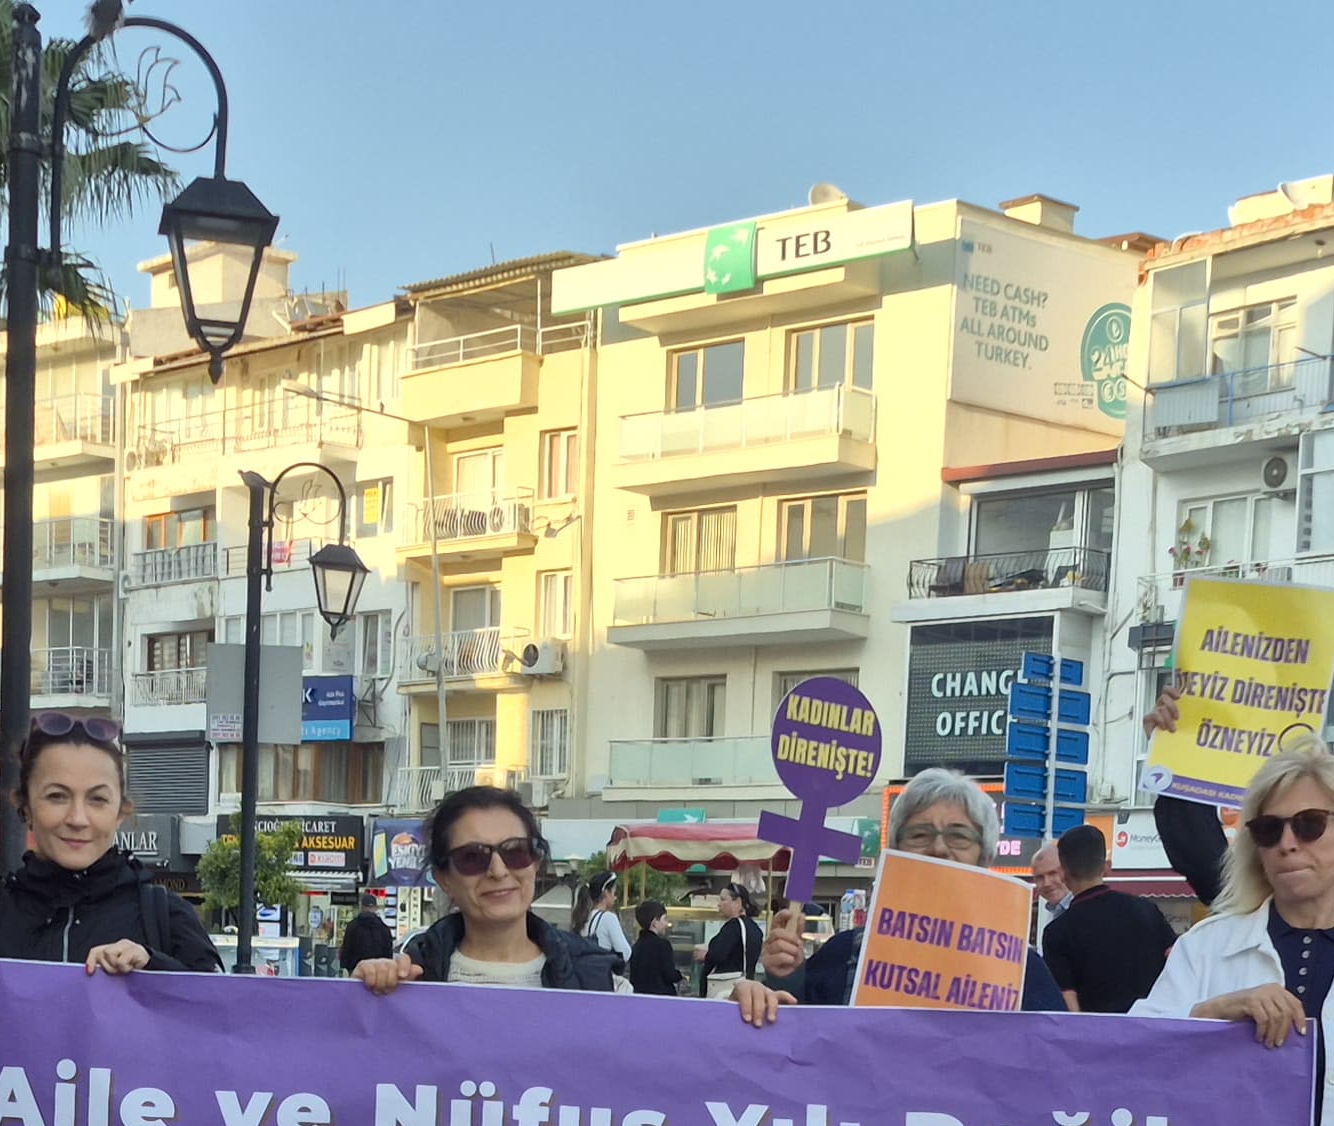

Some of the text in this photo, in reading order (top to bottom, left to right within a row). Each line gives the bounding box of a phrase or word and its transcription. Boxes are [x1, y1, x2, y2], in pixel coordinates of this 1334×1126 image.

[775, 229, 832, 262] TEB
[963, 273, 1049, 309] NEED CASH?
[972, 295, 1037, 329] TEB ATMs
[960, 316, 1050, 352] ALL AROUND
[1200, 625, 1311, 665] AİLENİZDEN
[930, 669, 1028, 698] CHANG
[785, 693, 876, 737] KADINLAR
[935, 710, 1018, 737] OFFIC
[1195, 717, 1278, 757] ÖZNEYİZ
[776, 731, 875, 781] DİRENİŞTE!
[301, 835, 356, 851] AKSESUAR
[876, 907, 1024, 965] BATSIN BATSIN
[863, 959, 943, 1001] KUTSAL
